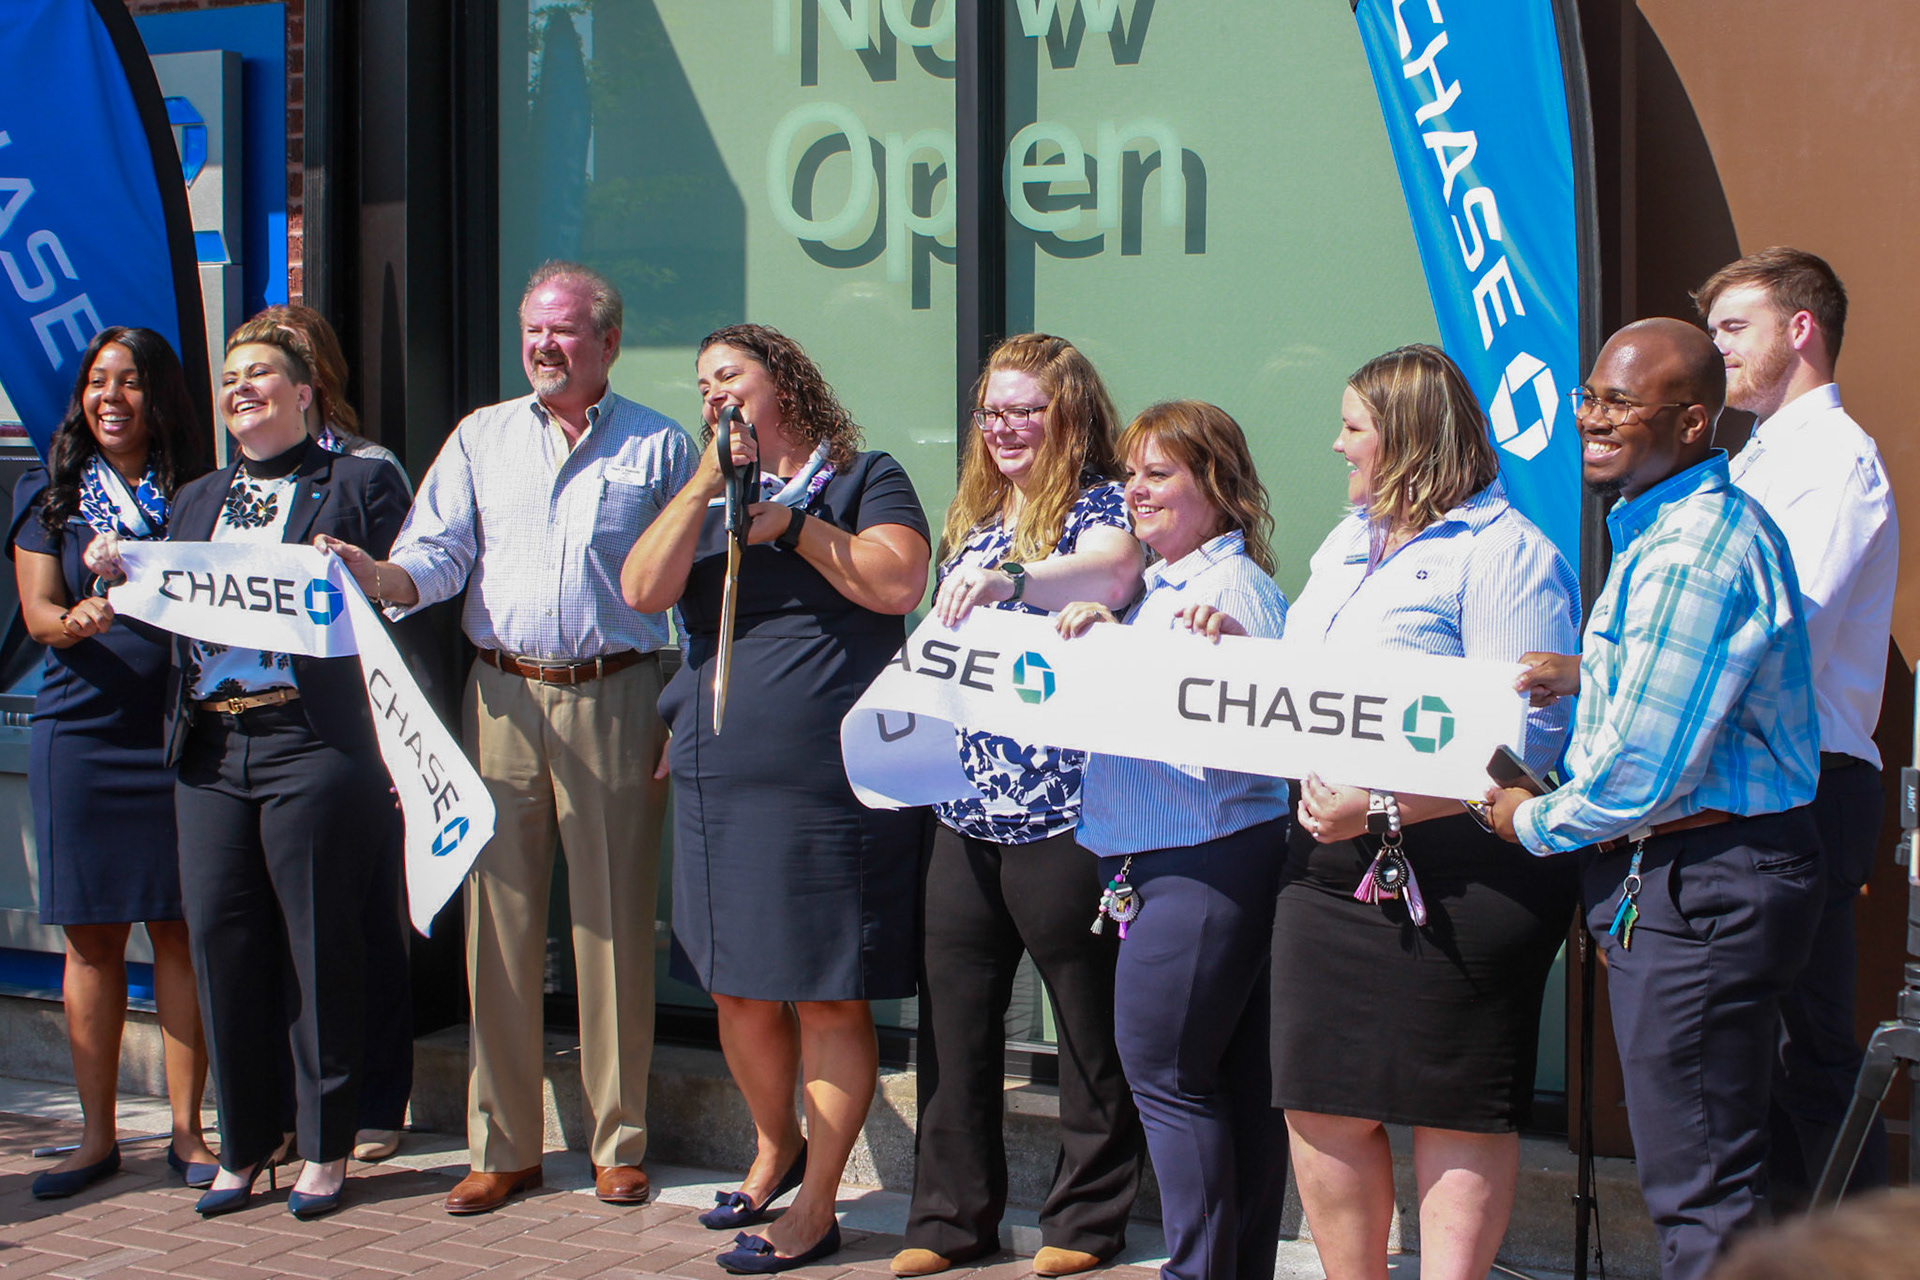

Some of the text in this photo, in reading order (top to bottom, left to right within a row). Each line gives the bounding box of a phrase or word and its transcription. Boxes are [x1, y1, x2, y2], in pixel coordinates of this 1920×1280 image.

[0, 130, 106, 371] ASE
[766, 101, 1207, 310] Open
[159, 570, 298, 616] CHASE
[369, 668, 460, 824] CHASE
[1178, 677, 1388, 742] CHASE
[1907, 784, 1916, 813] JOBY
